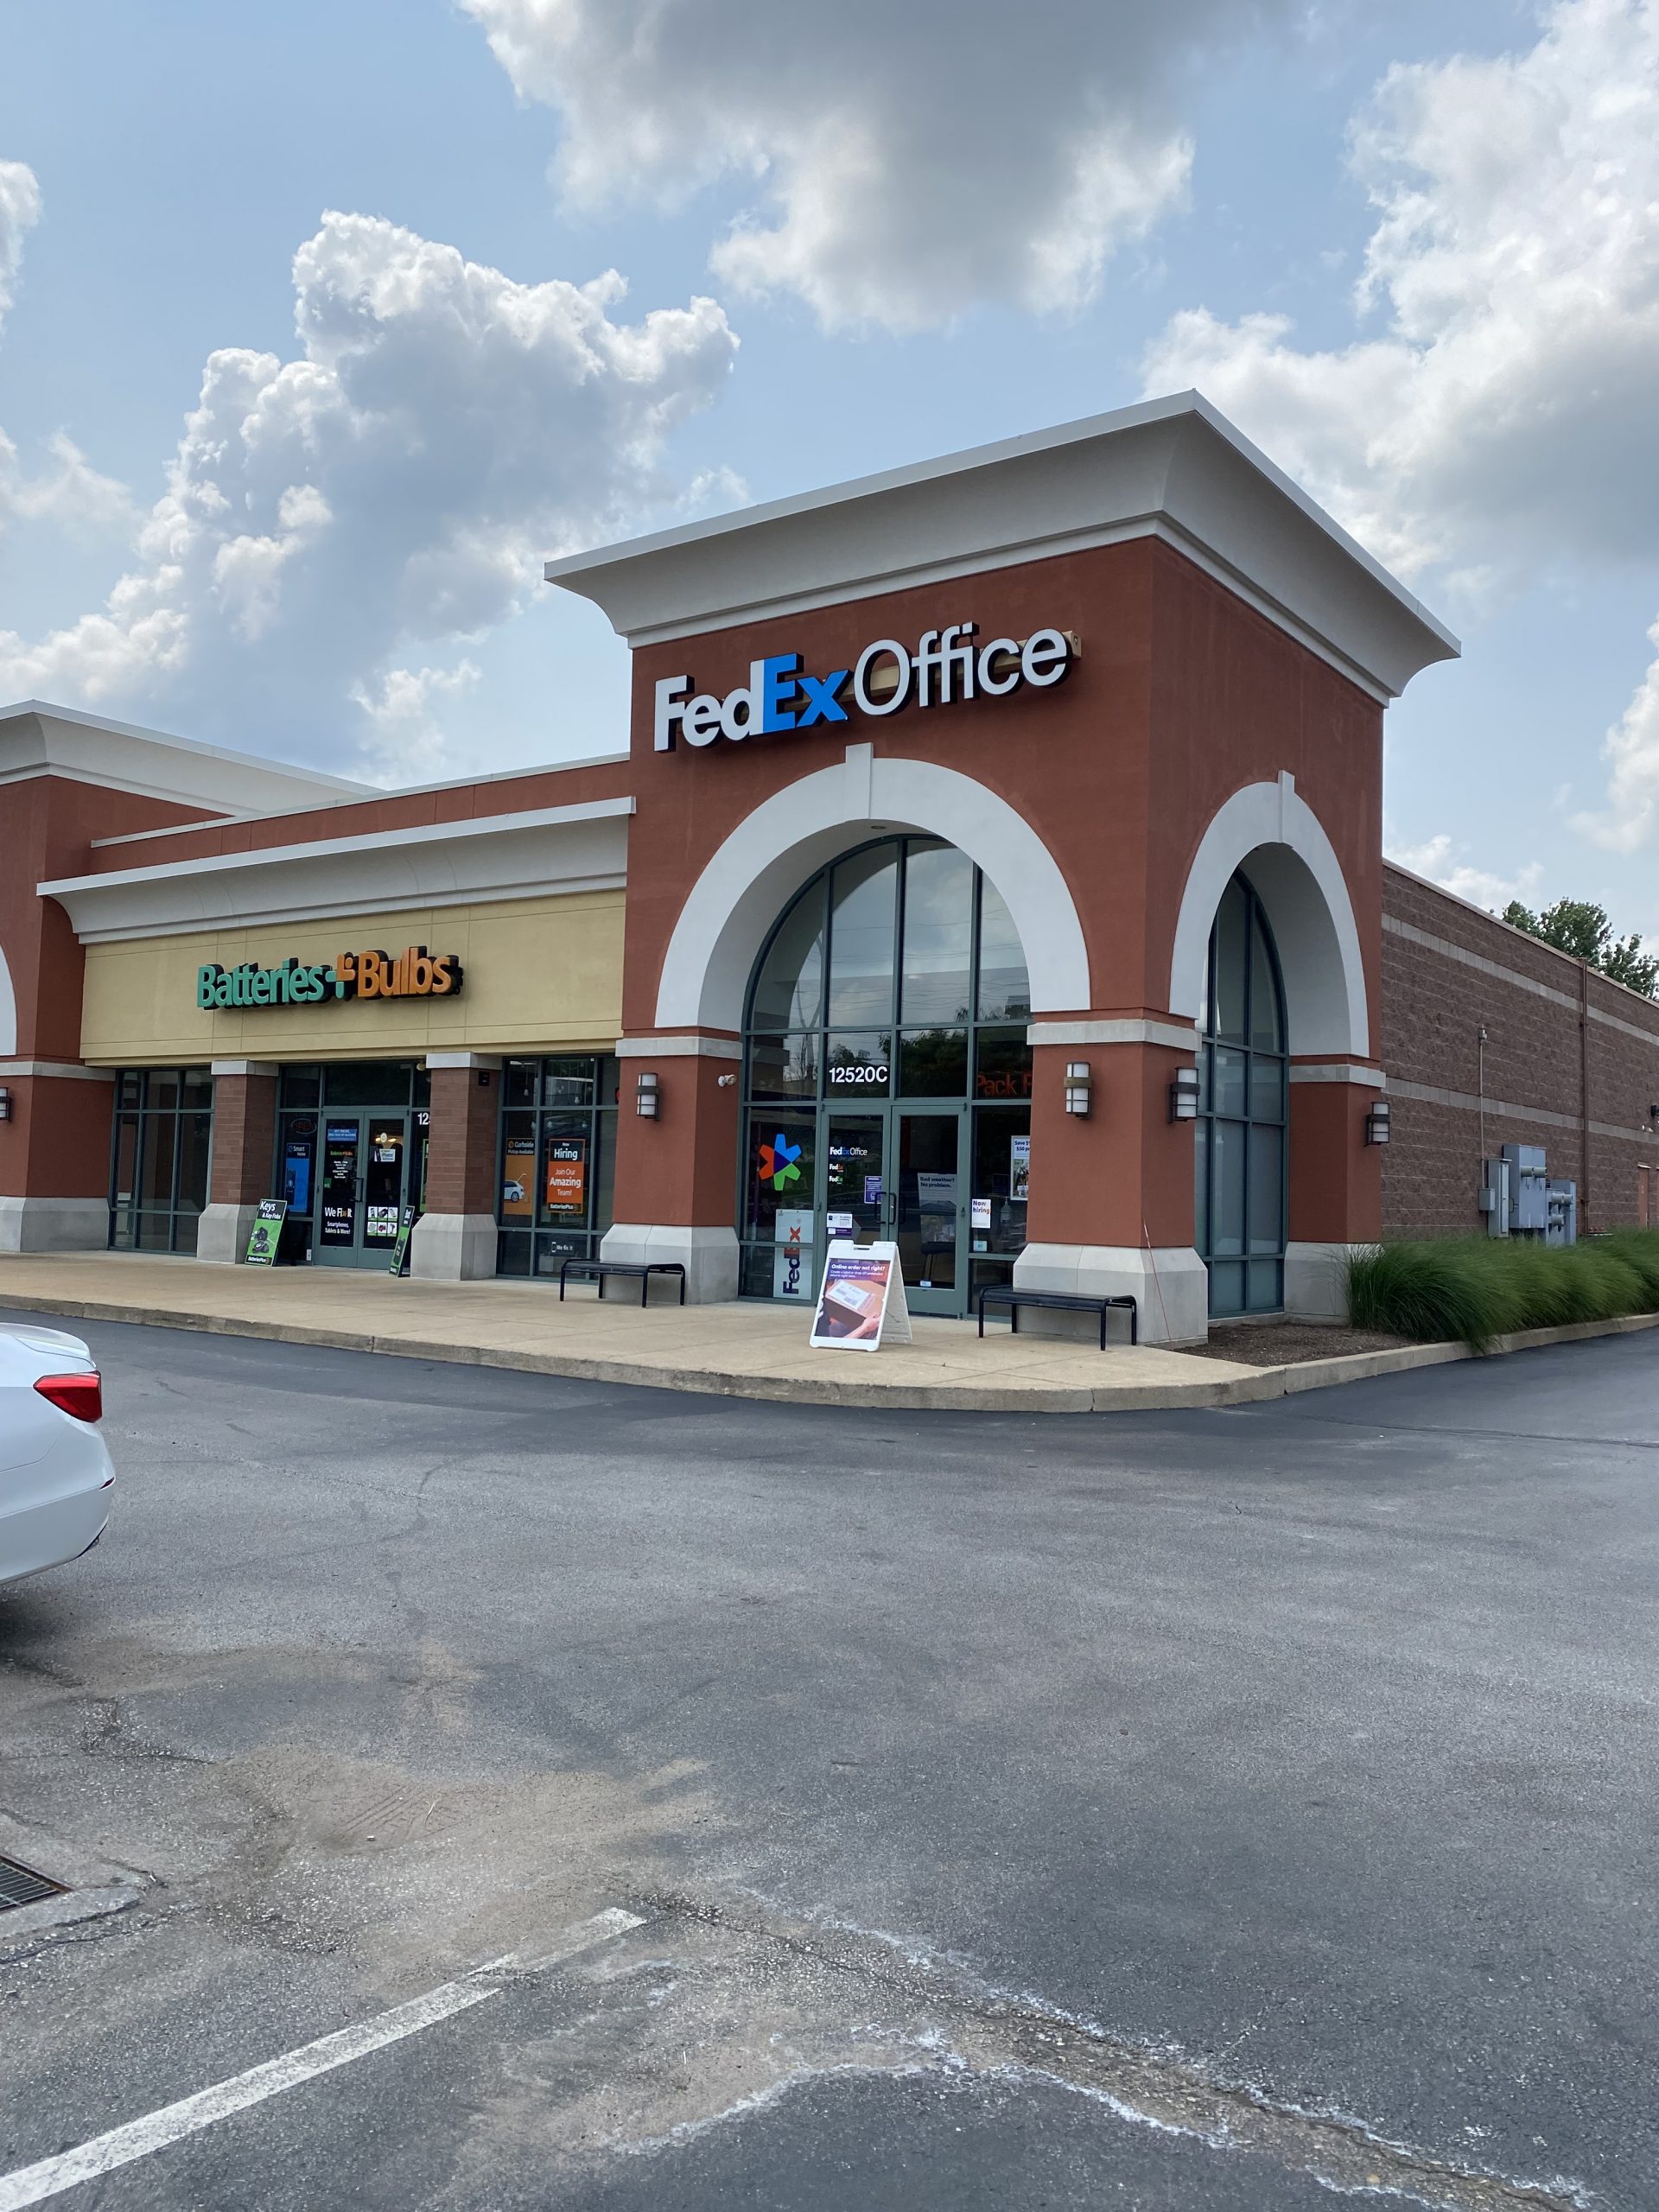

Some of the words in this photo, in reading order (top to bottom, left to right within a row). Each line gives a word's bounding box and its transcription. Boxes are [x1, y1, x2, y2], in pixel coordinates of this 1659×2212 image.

[654, 652, 851, 753] FedEx
[852, 620, 1069, 717] Office
[196, 958, 326, 1008] Batteries
[358, 946, 453, 999] Bulbs
[829, 1065, 888, 1083] 12520C
[554, 1147, 578, 1160] Hiring
[830, 1147, 849, 1155] FedEx
[849, 1147, 868, 1155] Office
[550, 1177, 582, 1188] Amazing
[259, 1200, 276, 1212] Keys
[324, 1206, 337, 1217] We
